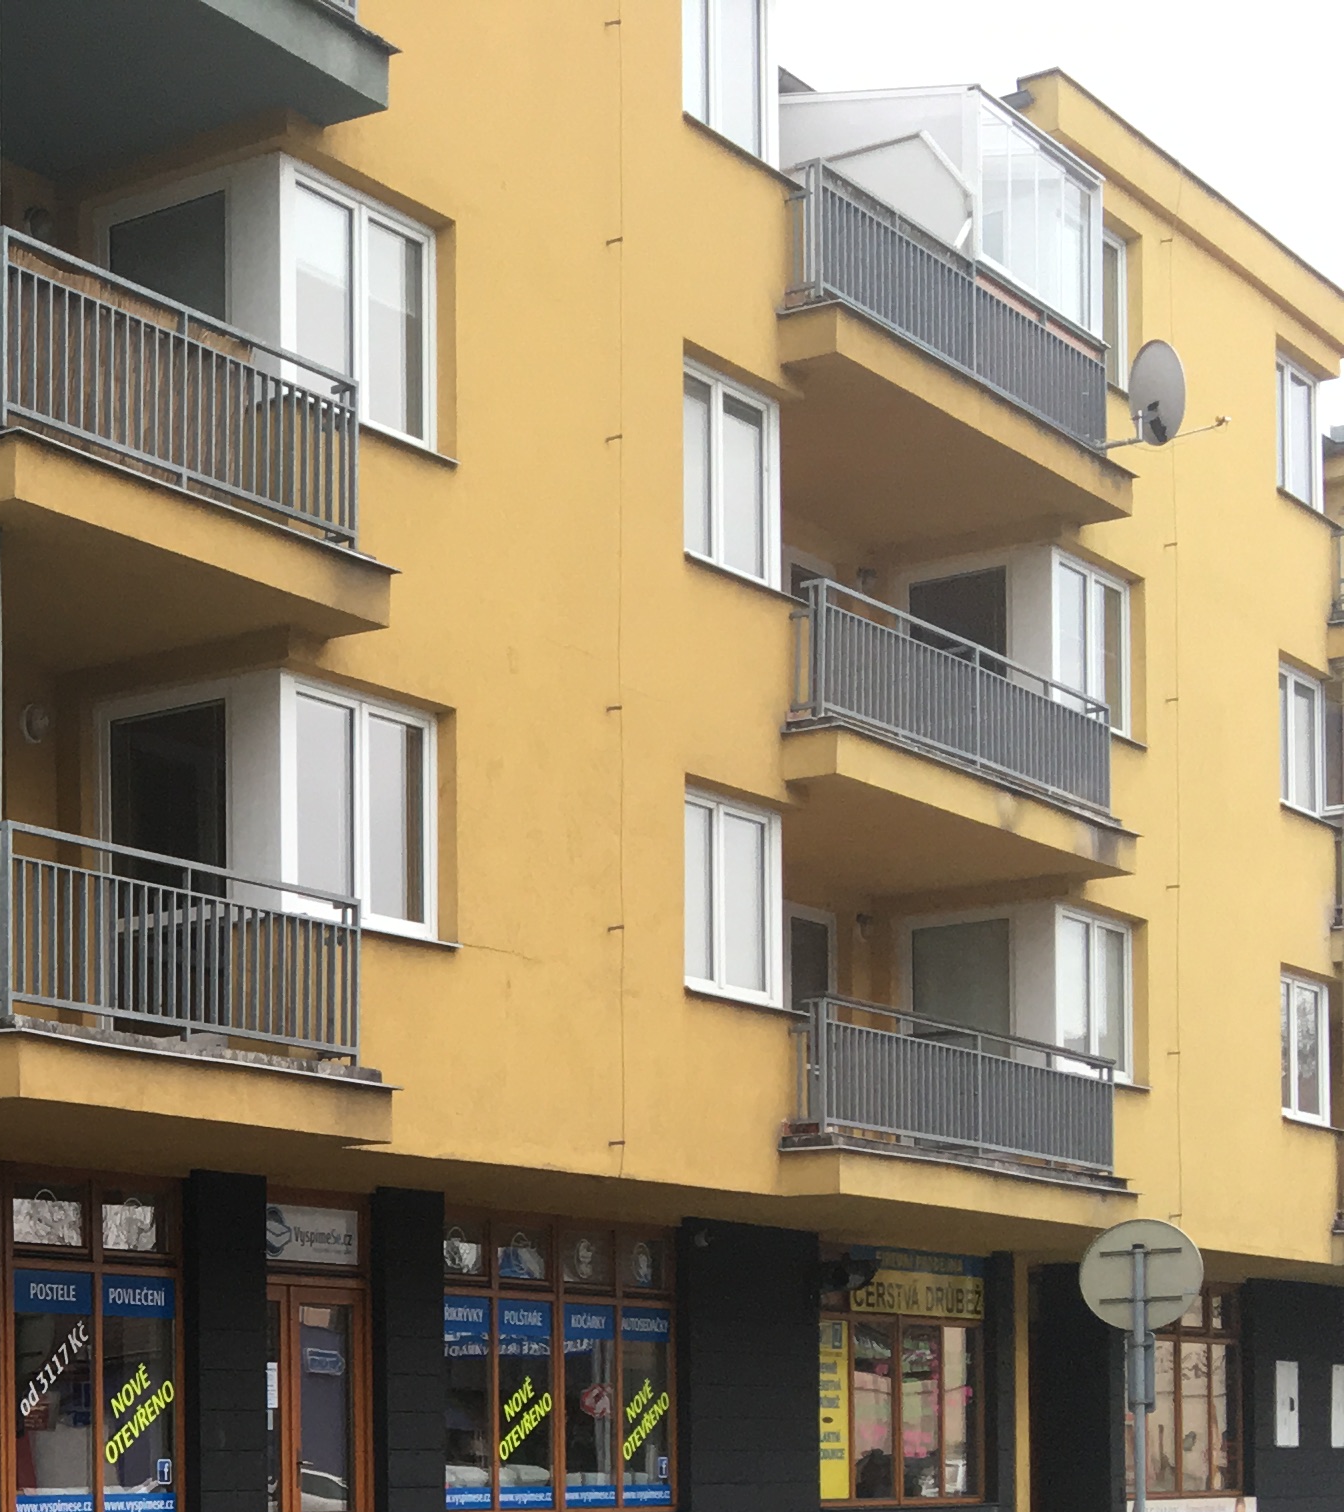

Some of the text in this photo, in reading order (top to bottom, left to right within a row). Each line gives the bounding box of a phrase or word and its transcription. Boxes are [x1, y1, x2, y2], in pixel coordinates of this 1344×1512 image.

[30, 1283, 76, 1302] POSTELE
[108, 1286, 165, 1306] POVLEČENÍ
[444, 1304, 484, 1323] ŘIKRÝVKY
[504, 1308, 544, 1327] POLŠTÁŘE
[571, 1312, 607, 1329] KOČÁRKY
[21, 1320, 89, 1416] od 3117 Kč
[111, 1362, 152, 1418] NOVĚ
[105, 1380, 175, 1464] OTEVŘENO
[503, 1375, 535, 1423] NOVĚ
[625, 1378, 654, 1424] NOVĚ
[499, 1392, 553, 1461] OTEVŘENO
[622, 1392, 670, 1461] OTEVŘENO
